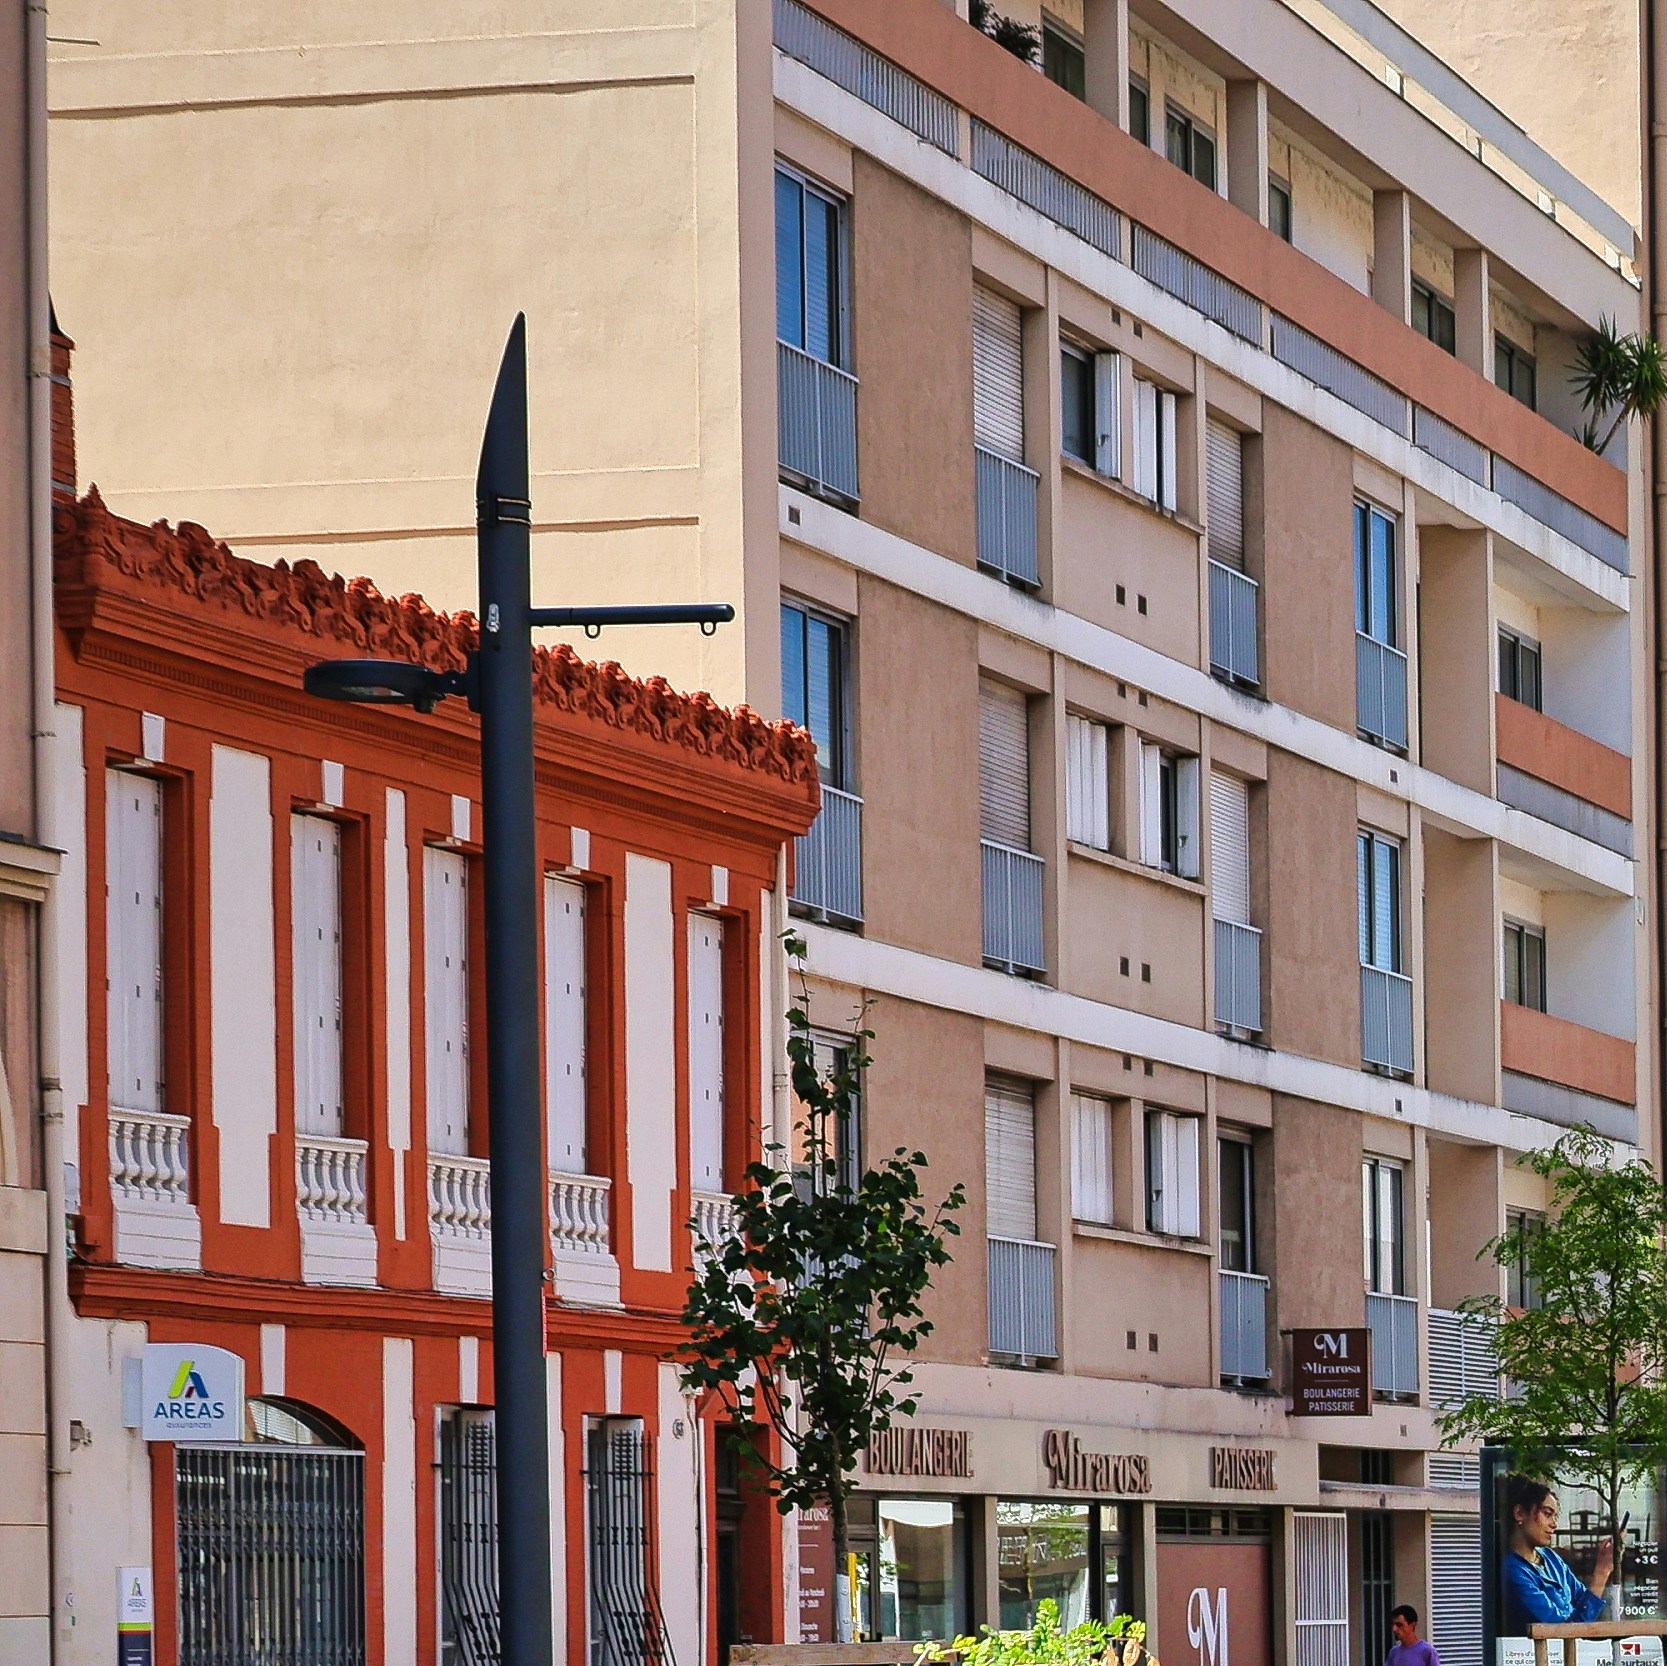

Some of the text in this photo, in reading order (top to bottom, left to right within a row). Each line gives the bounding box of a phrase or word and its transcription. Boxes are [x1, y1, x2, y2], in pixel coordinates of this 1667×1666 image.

[1302, 1362, 1361, 1374] Mirarosa
[1303, 1388, 1360, 1398] BOULANGERIE
[154, 1402, 225, 1419] AREAS
[1309, 1401, 1355, 1411] PATISSERIE
[866, 1427, 1278, 1493] BOULANGERIE Mirarosa PATISSERIE
